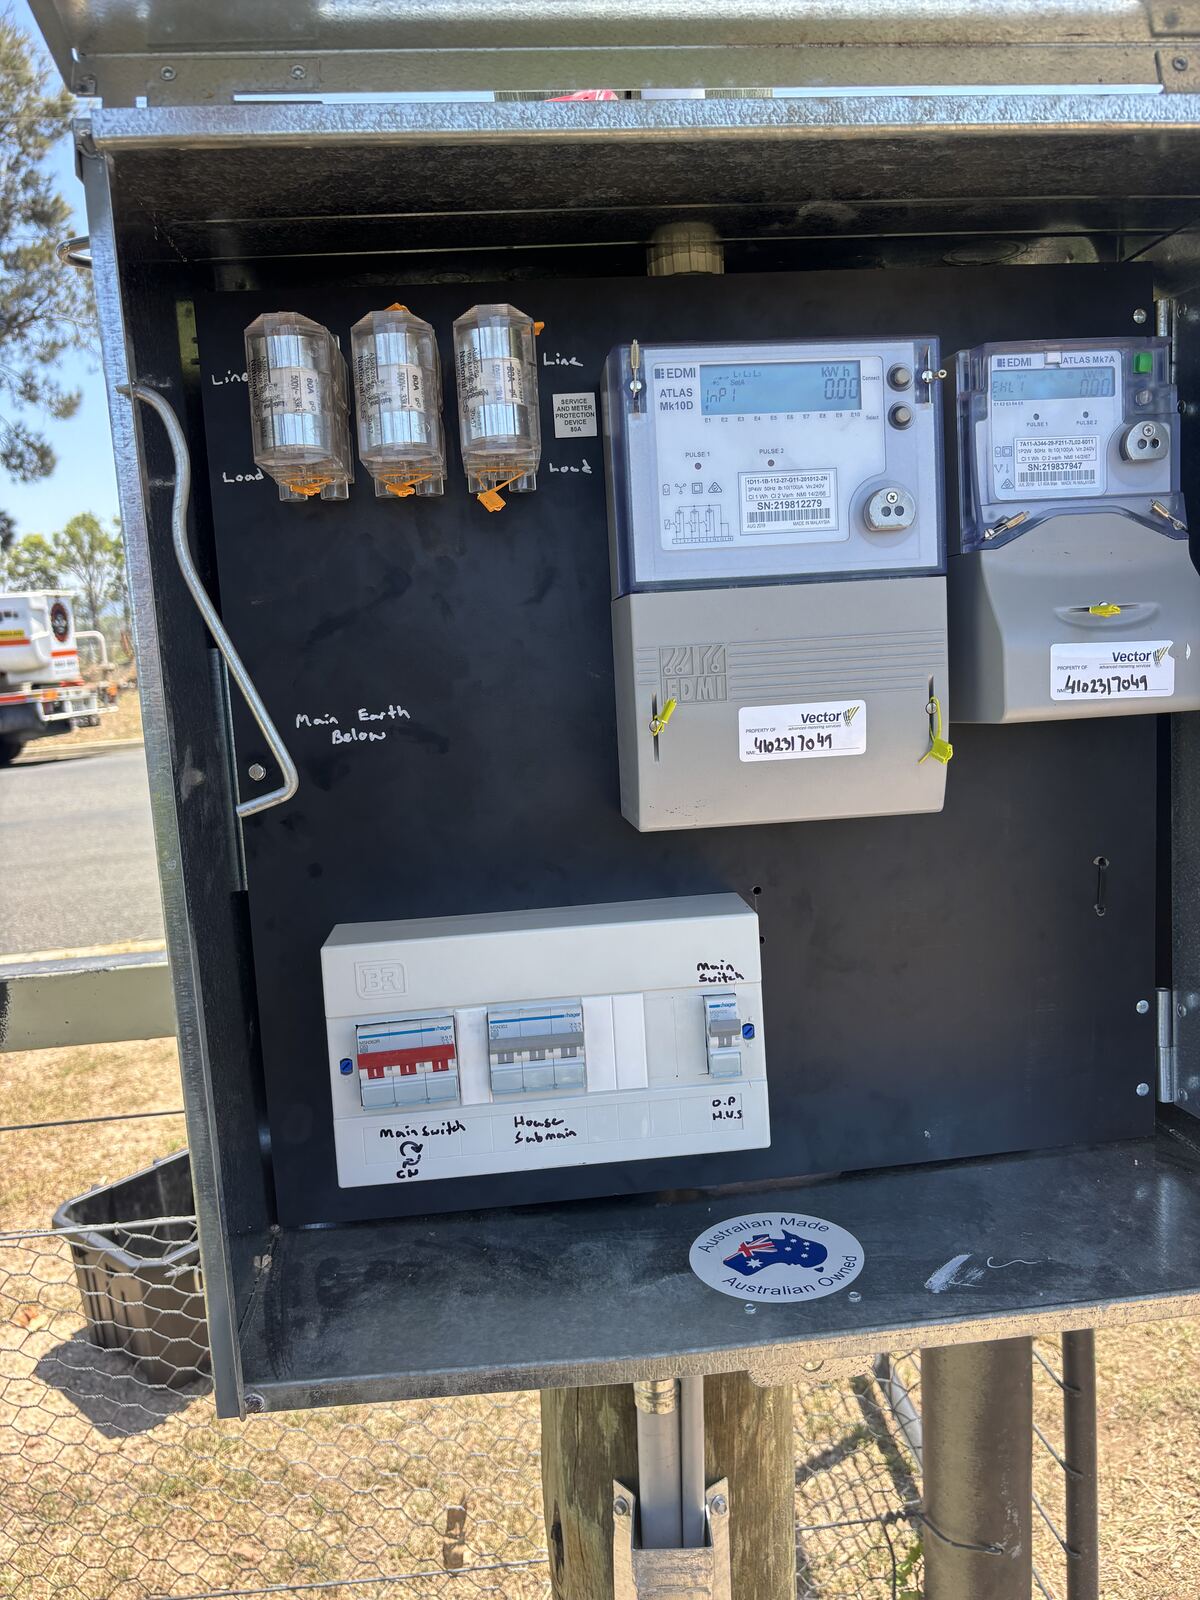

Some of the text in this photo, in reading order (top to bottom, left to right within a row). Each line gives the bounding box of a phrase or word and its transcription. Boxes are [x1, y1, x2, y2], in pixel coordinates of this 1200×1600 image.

[543, 352, 584, 367] Line
[1007, 358, 1032, 367] EDMI
[1063, 355, 1115, 364] ATLAS Mk7A
[211, 370, 249, 386] Line
[666, 367, 696, 379] EDMI
[412, 374, 420, 391] 80A
[660, 388, 693, 398] ATLAS
[660, 401, 694, 412] Mk10D
[548, 459, 592, 474] Load
[1028, 462, 1082, 471] SN:219837947
[222, 468, 264, 483] Load
[757, 499, 822, 510] SN:219812279
[1112, 651, 1152, 662] Vector
[665, 676, 727, 700] EDMI
[295, 704, 411, 729] Main Earth
[801, 712, 842, 724] Vector
[331, 727, 386, 745] Below
[696, 959, 735, 972] Main
[698, 972, 744, 983] Switch
[514, 1116, 564, 1128] House
[698, 1217, 830, 1254] Australian Made
[722, 1255, 857, 1296] Australian Owned
